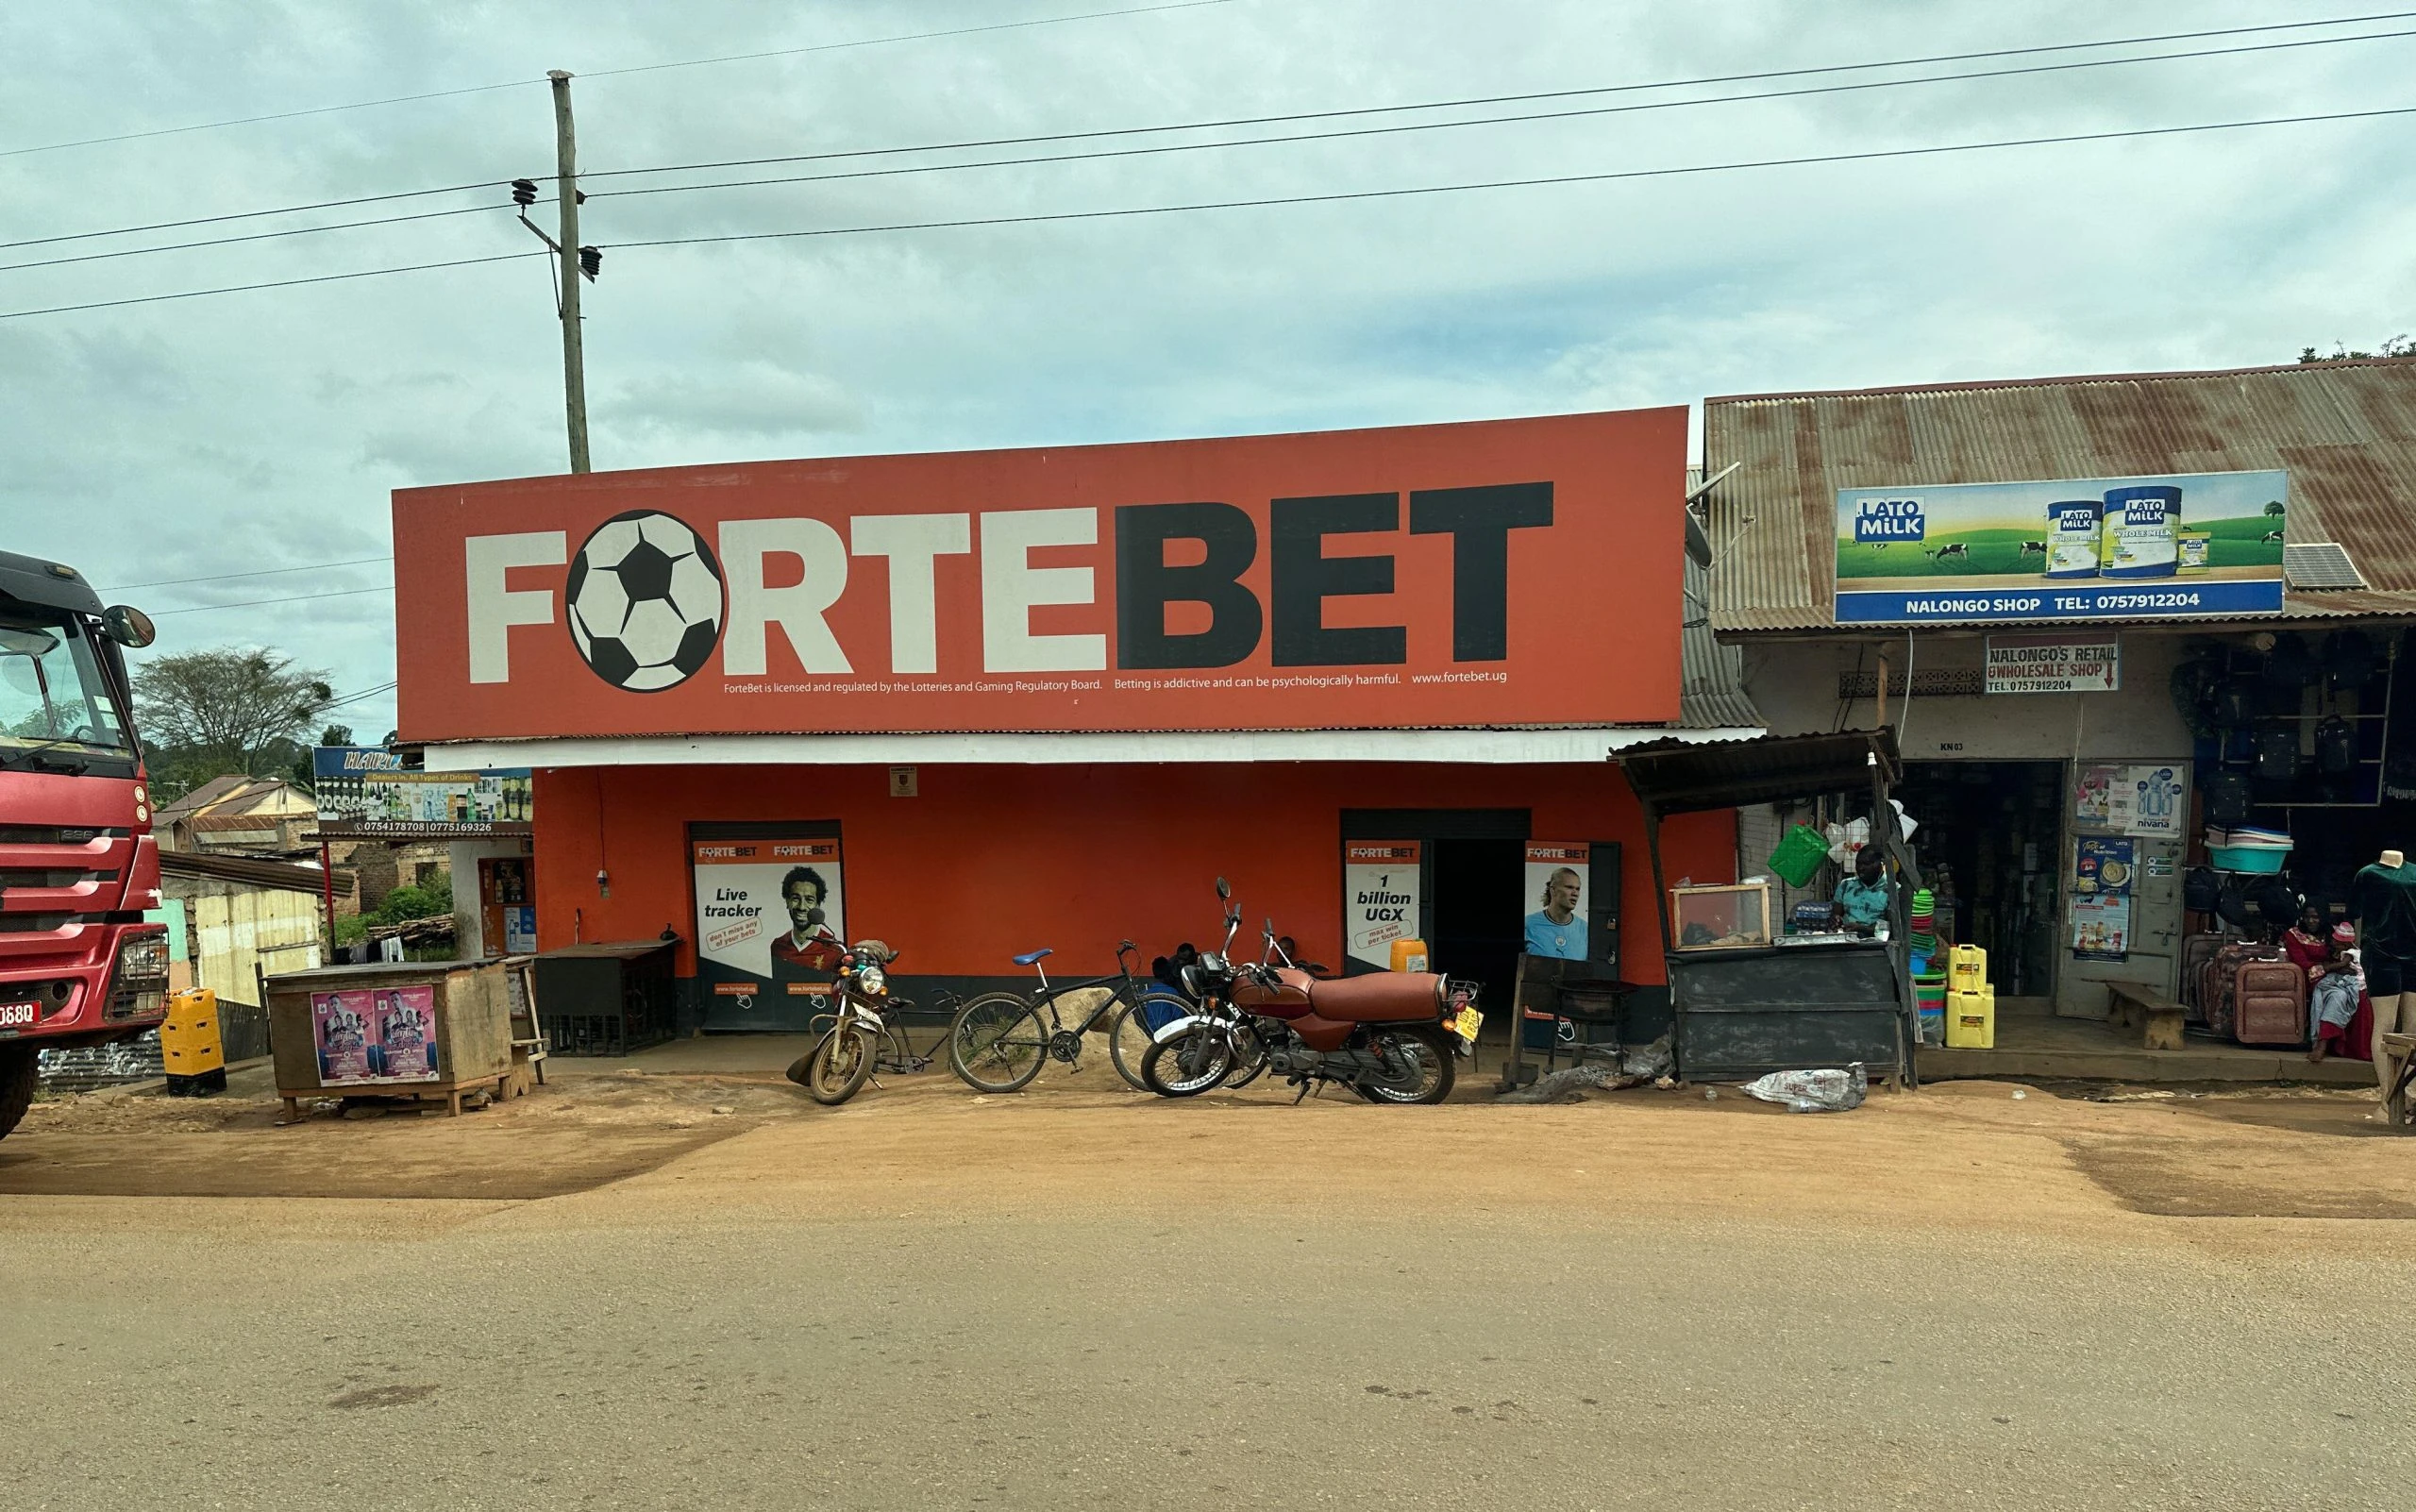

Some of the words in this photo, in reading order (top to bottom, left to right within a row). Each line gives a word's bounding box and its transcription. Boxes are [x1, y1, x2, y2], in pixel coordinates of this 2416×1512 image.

[1862, 500, 1919, 516] LATO
[2129, 501, 2162, 511] LATO
[2063, 511, 2090, 519] LATO
[2113, 529, 2147, 538] WHOLE
[1906, 598, 1990, 613] NALONGO
[1994, 597, 2041, 612] SHOP
[2055, 596, 2090, 610] TEL:
[2097, 593, 2200, 609] 0757912204
[1989, 647, 2069, 663] NALONGO'S
[2074, 647, 2118, 662] RETAIL
[2070, 664, 2103, 677] SHOP
[725, 682, 763, 694] ForteBet
[765, 683, 771, 692] is
[774, 681, 811, 692] licensed
[814, 681, 830, 691] and
[833, 681, 877, 695] regulated
[880, 681, 891, 695] by
[894, 681, 909, 691] the
[912, 681, 952, 692] Lotteries
[955, 681, 972, 691] and
[975, 680, 1013, 694] Gaming
[1016, 680, 1068, 694] Regulatory
[1071, 679, 1102, 690] Board.
[1115, 679, 1150, 691] Betting
[1154, 679, 1161, 688] is
[1164, 677, 1210, 688] addictive
[1213, 676, 1232, 687] and
[1235, 679, 1253, 687] can
[1256, 676, 1269, 686] be
[1272, 674, 1353, 690] psychologically
[1356, 673, 1401, 685] harmful.
[1412, 671, 1507, 684] www.fortebet.ug
[419, 774, 440, 782] Types
[2138, 819, 2170, 829] nivana
[698, 847, 757, 857] FORTEBET
[774, 845, 833, 856] FORTEBET
[1351, 848, 1415, 858] FORTEBET
[1527, 848, 1586, 859] FORTEBET
[1380, 875, 1388, 887] 1
[715, 888, 747, 900] Live
[1357, 891, 1410, 905] billion
[704, 904, 762, 917] tracker
[1365, 908, 1404, 921] UGX
[709, 929, 726, 942] don't
[728, 925, 744, 935] miss
[746, 920, 758, 932] any
[1368, 929, 1385, 937] max
[1388, 924, 1399, 932] win
[715, 938, 724, 948] of
[725, 933, 740, 945] your
[741, 929, 756, 939] bets
[1367, 936, 1380, 946] per
[1382, 930, 1402, 942] ticket
[1784, 1083, 1808, 1093] SUPER
